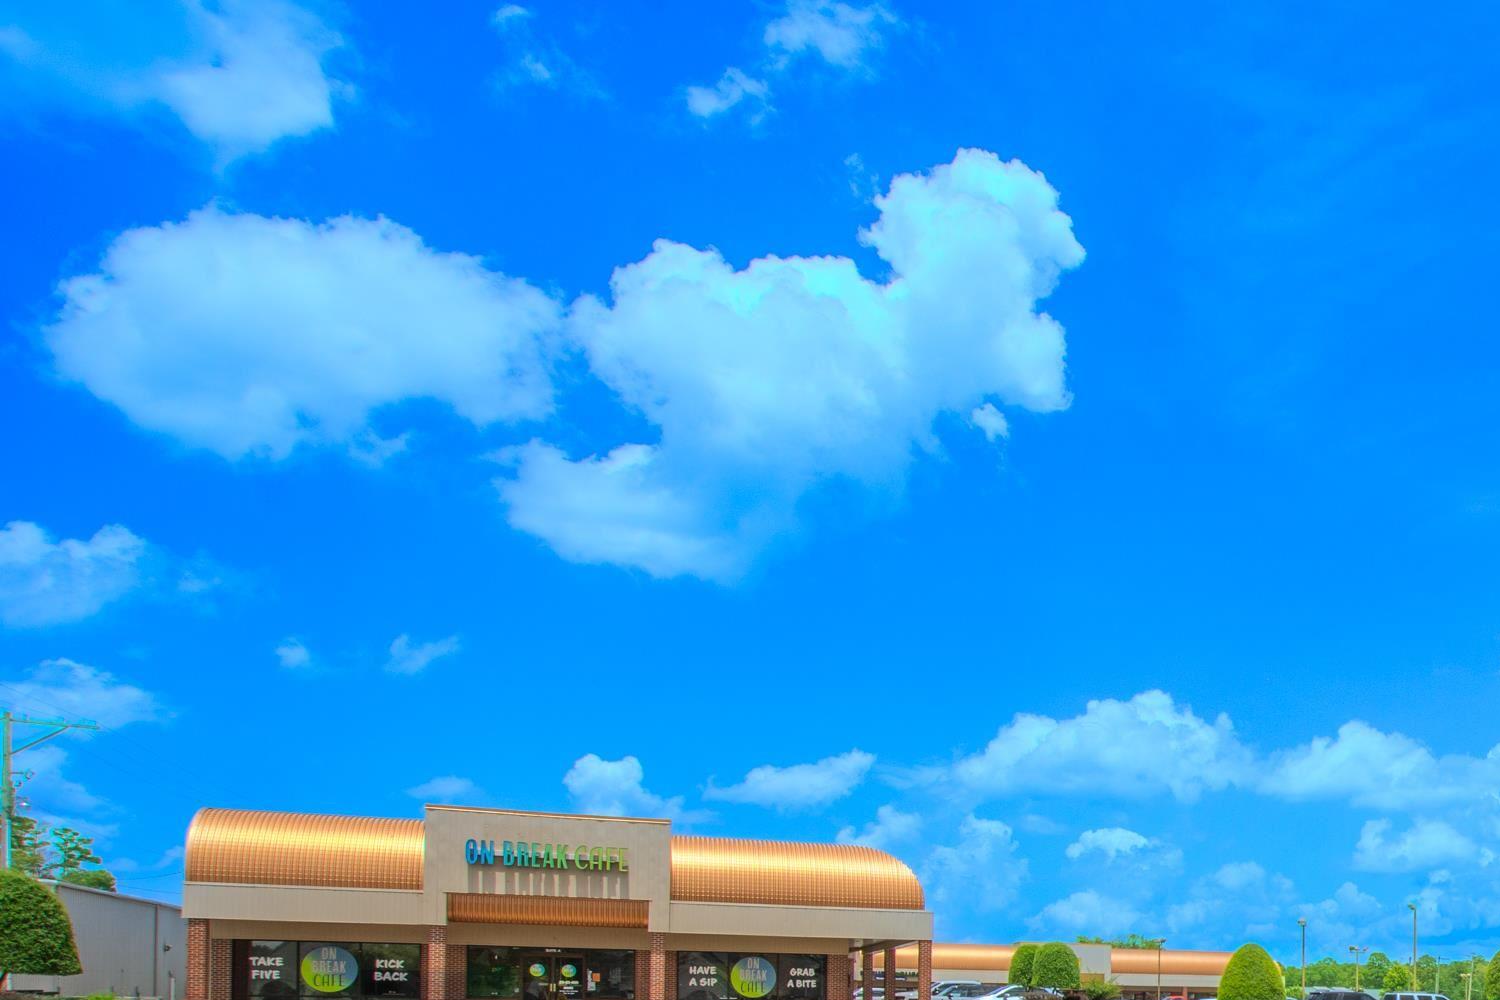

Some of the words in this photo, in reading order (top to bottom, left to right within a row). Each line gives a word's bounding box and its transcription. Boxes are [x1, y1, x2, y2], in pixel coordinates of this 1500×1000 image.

[465, 838, 495, 865] ON
[503, 841, 568, 870] BREAK
[574, 845, 629, 872] CAFE
[322, 947, 337, 960] ON
[248, 957, 284, 967] TAKE
[312, 960, 346, 974] BREAK
[376, 959, 405, 969] KICK
[747, 957, 760, 969] ON
[251, 969, 281, 980] FIVE
[689, 966, 717, 975] HAVE
[739, 969, 768, 981] BREAK
[790, 968, 815, 977] GRAB
[313, 974, 345, 987] CAFE
[374, 972, 408, 982] BACK
[689, 978, 697, 987] A
[699, 977, 717, 987] SIP
[787, 980, 795, 988] A
[796, 980, 817, 988] BITE
